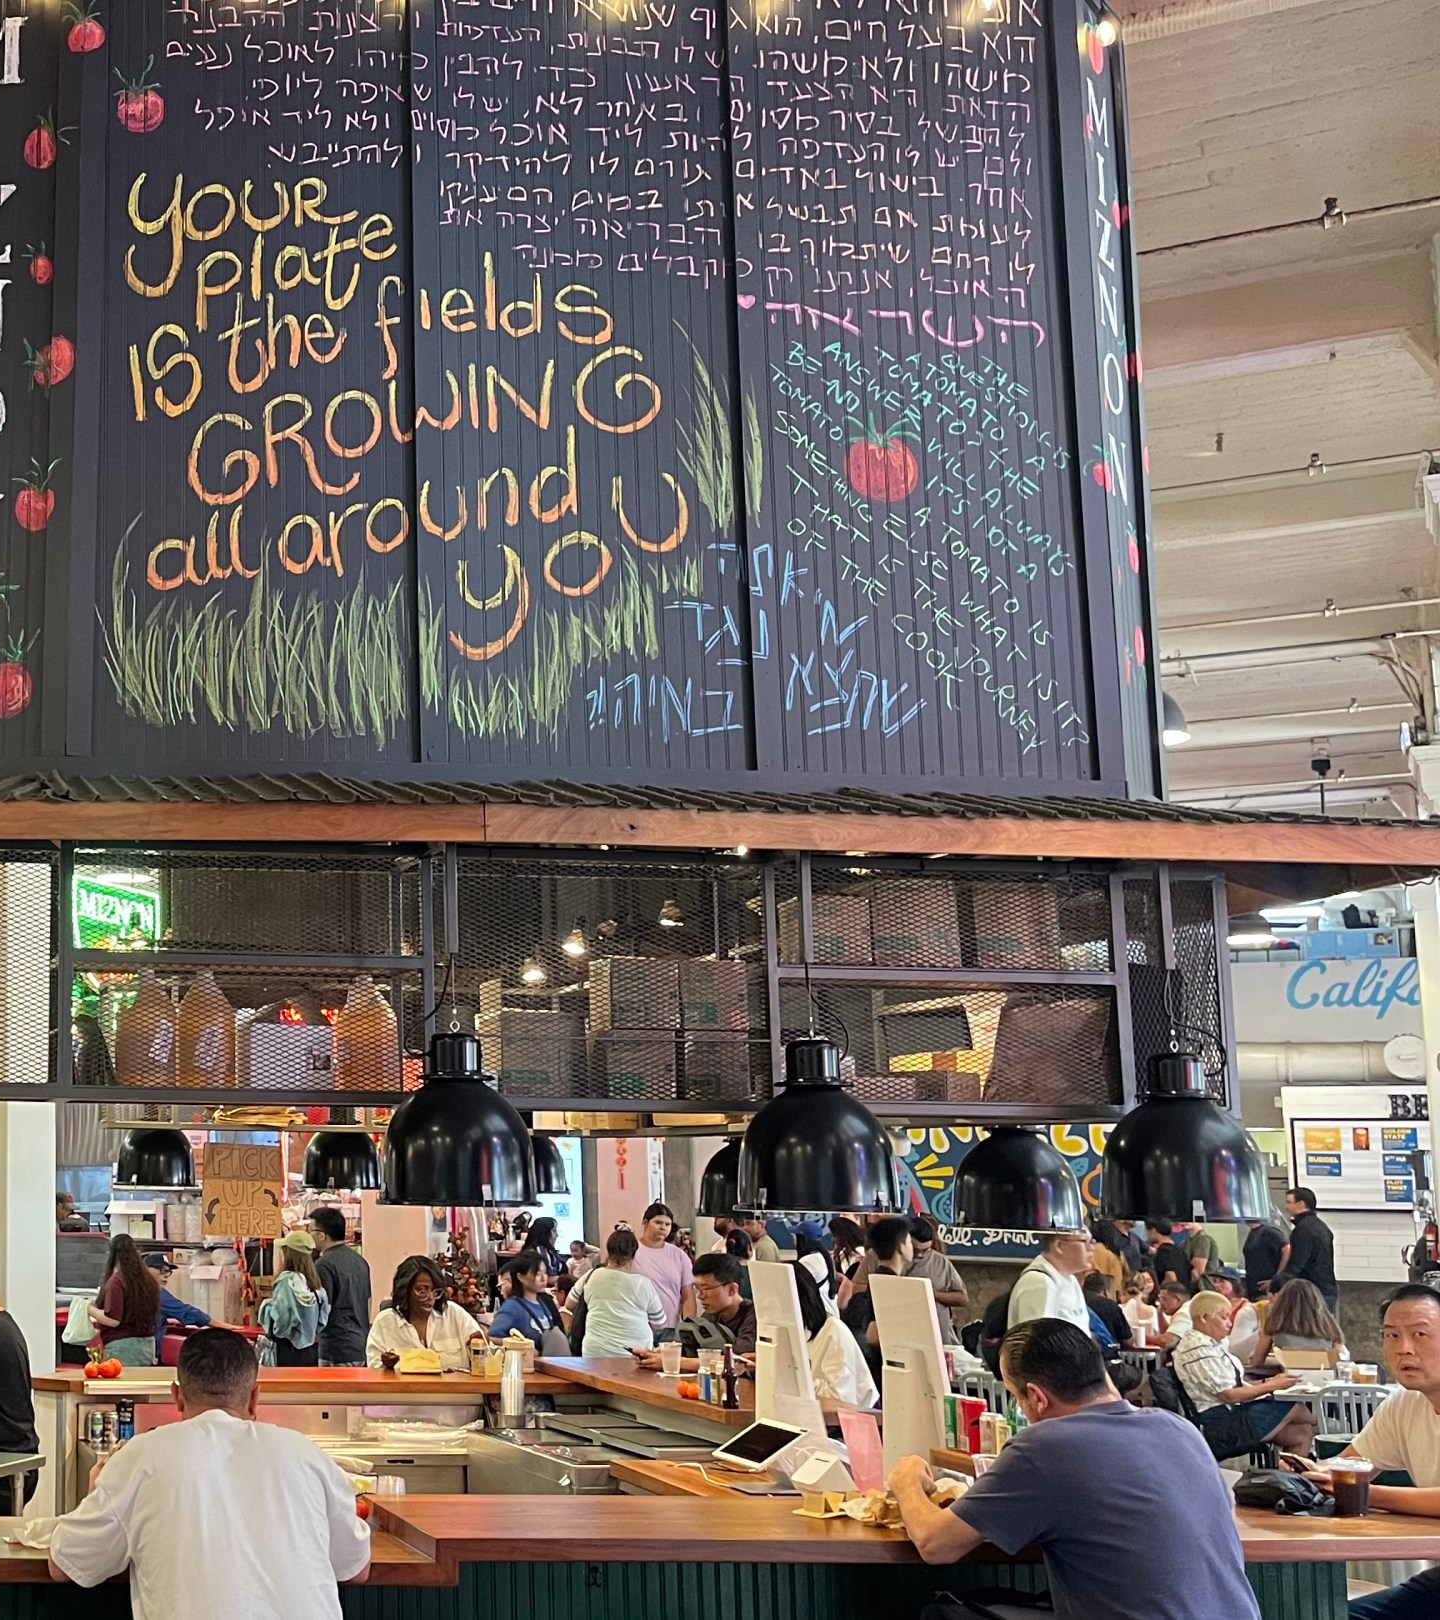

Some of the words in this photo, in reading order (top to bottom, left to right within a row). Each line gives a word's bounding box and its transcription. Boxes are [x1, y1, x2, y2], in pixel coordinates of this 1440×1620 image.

[196, 214, 396, 332] plate
[1086, 77, 1128, 506] MIZNON
[219, 291, 347, 393] the
[375, 252, 613, 379] fields
[786, 341, 822, 375] BE
[821, 377, 861, 412] NO
[822, 342, 922, 432] ANSWER
[981, 355, 1029, 397] THE
[188, 346, 661, 505] GROWING
[147, 505, 260, 590] all
[278, 425, 577, 577] around
[787, 517, 827, 552] OF
[841, 554, 887, 606] THE
[78, 888, 154, 932] MIZNON
[212, 1147, 279, 1178] PICK
[223, 1180, 263, 1207] UP
[220, 1208, 277, 1235] HERE
